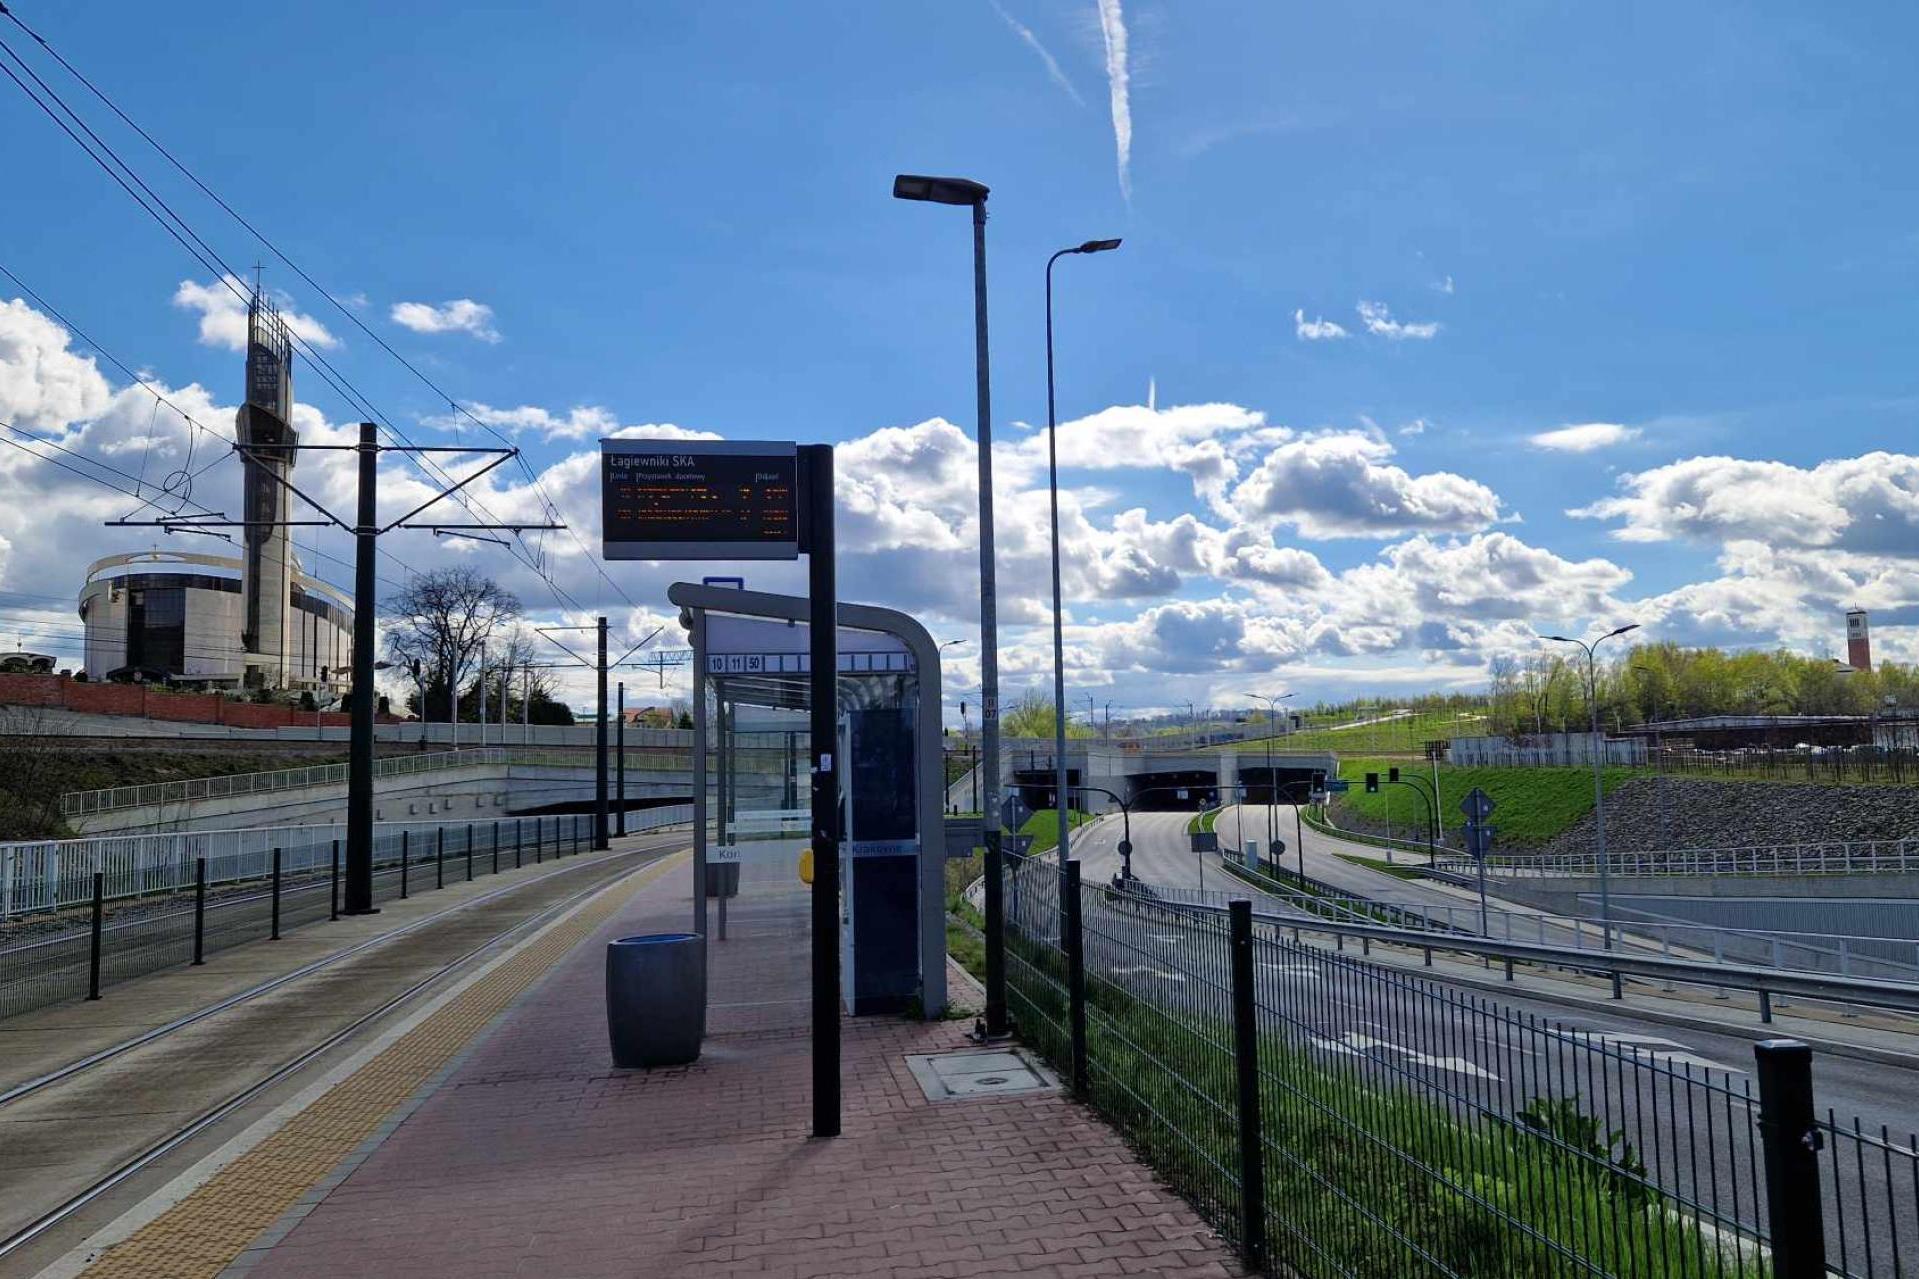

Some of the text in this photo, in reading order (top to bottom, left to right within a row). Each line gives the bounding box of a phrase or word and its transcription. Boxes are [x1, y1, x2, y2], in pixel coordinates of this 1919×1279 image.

[611, 455, 695, 469] Łagiewniki SKA
[713, 656, 760, 670] 10 11 50
